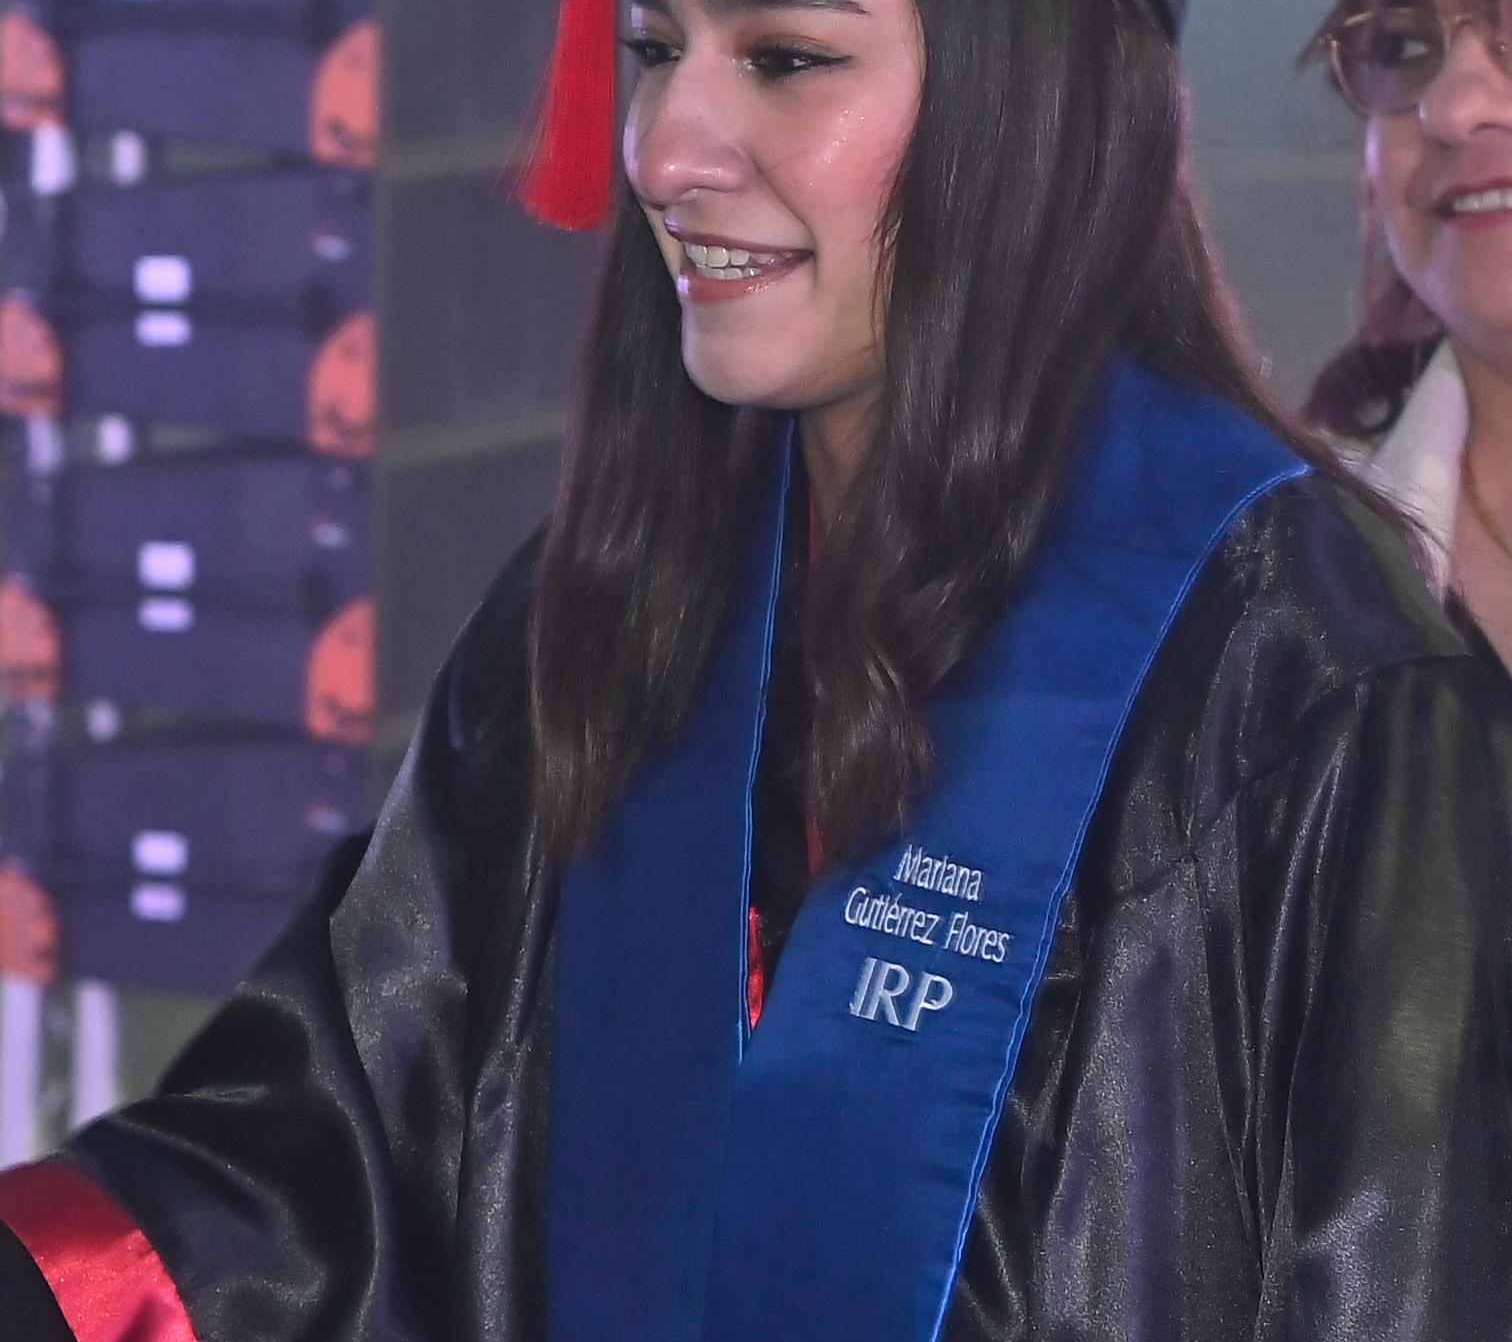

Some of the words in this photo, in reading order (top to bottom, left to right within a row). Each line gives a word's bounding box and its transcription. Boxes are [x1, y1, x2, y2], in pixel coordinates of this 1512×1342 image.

[893, 843, 983, 902] Mariana
[844, 885, 940, 946] Gutiérrez
[942, 910, 1011, 963] Flores
[849, 955, 954, 1032] IRP
